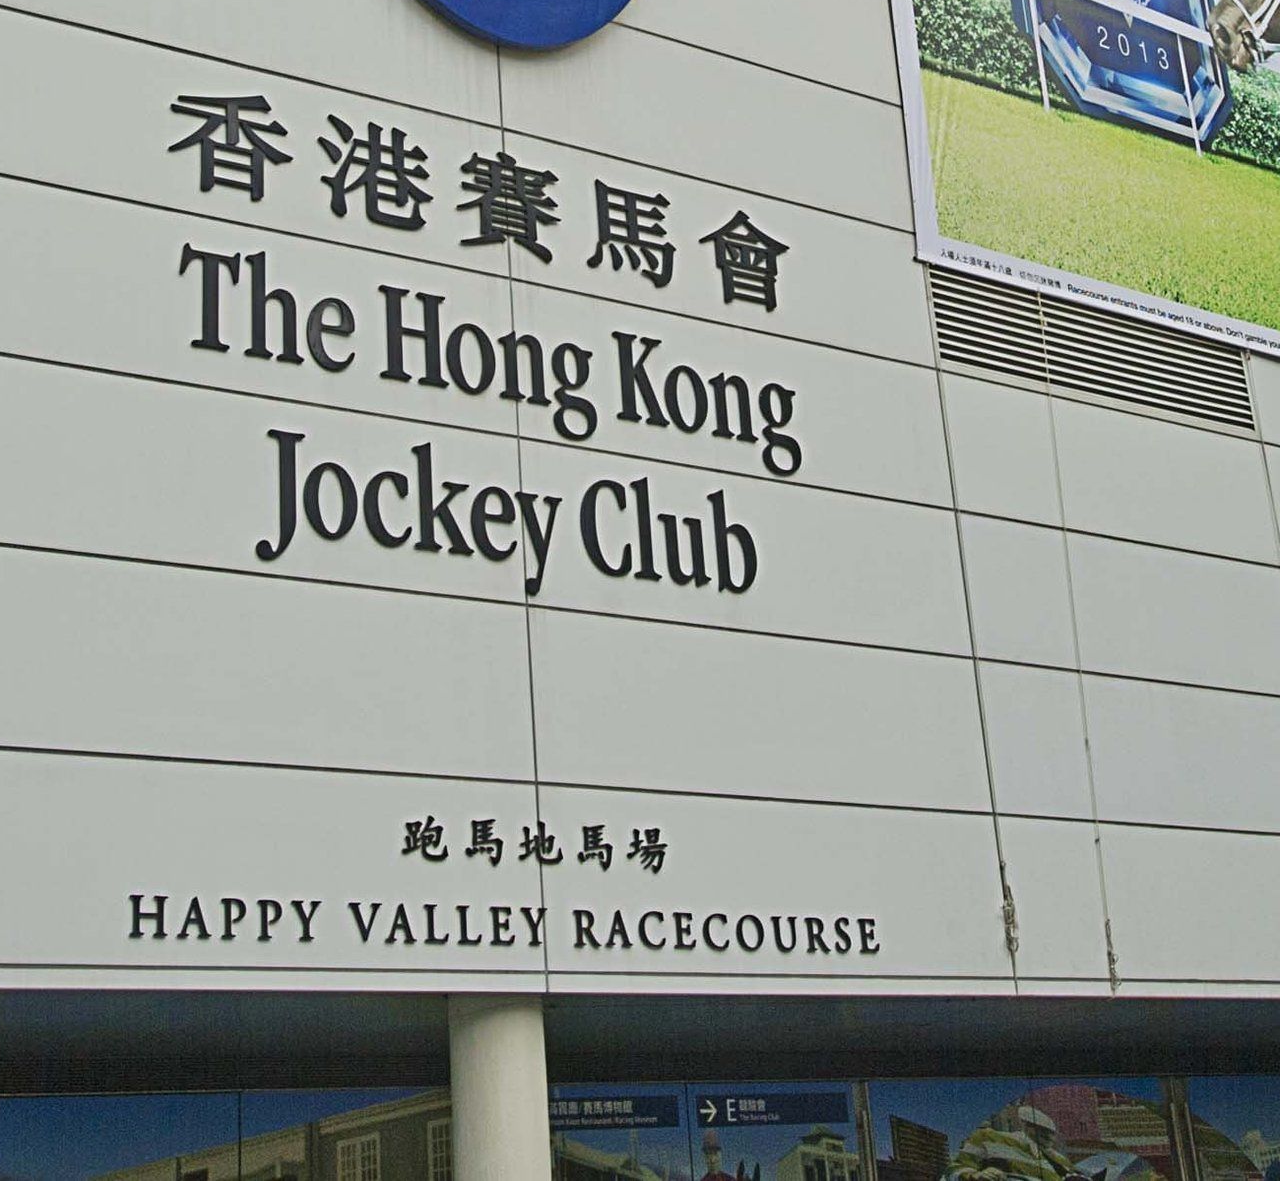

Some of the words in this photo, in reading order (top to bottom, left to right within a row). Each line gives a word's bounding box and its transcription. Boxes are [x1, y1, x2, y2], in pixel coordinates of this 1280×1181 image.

[1097, 26, 1169, 70] 2013
[168, 94, 790, 312] 香港賽馬會
[179, 242, 356, 372] The
[378, 284, 598, 441] Hong
[611, 331, 803, 476] Kong
[256, 428, 562, 595] Jockey
[579, 477, 759, 594] Club
[401, 816, 669, 875] 跑馬地馬場
[128, 893, 322, 943] HAPPY
[348, 901, 547, 948] VALLEY
[572, 908, 882, 956] RACECOURSE
[726, 1099, 737, 1121] E
